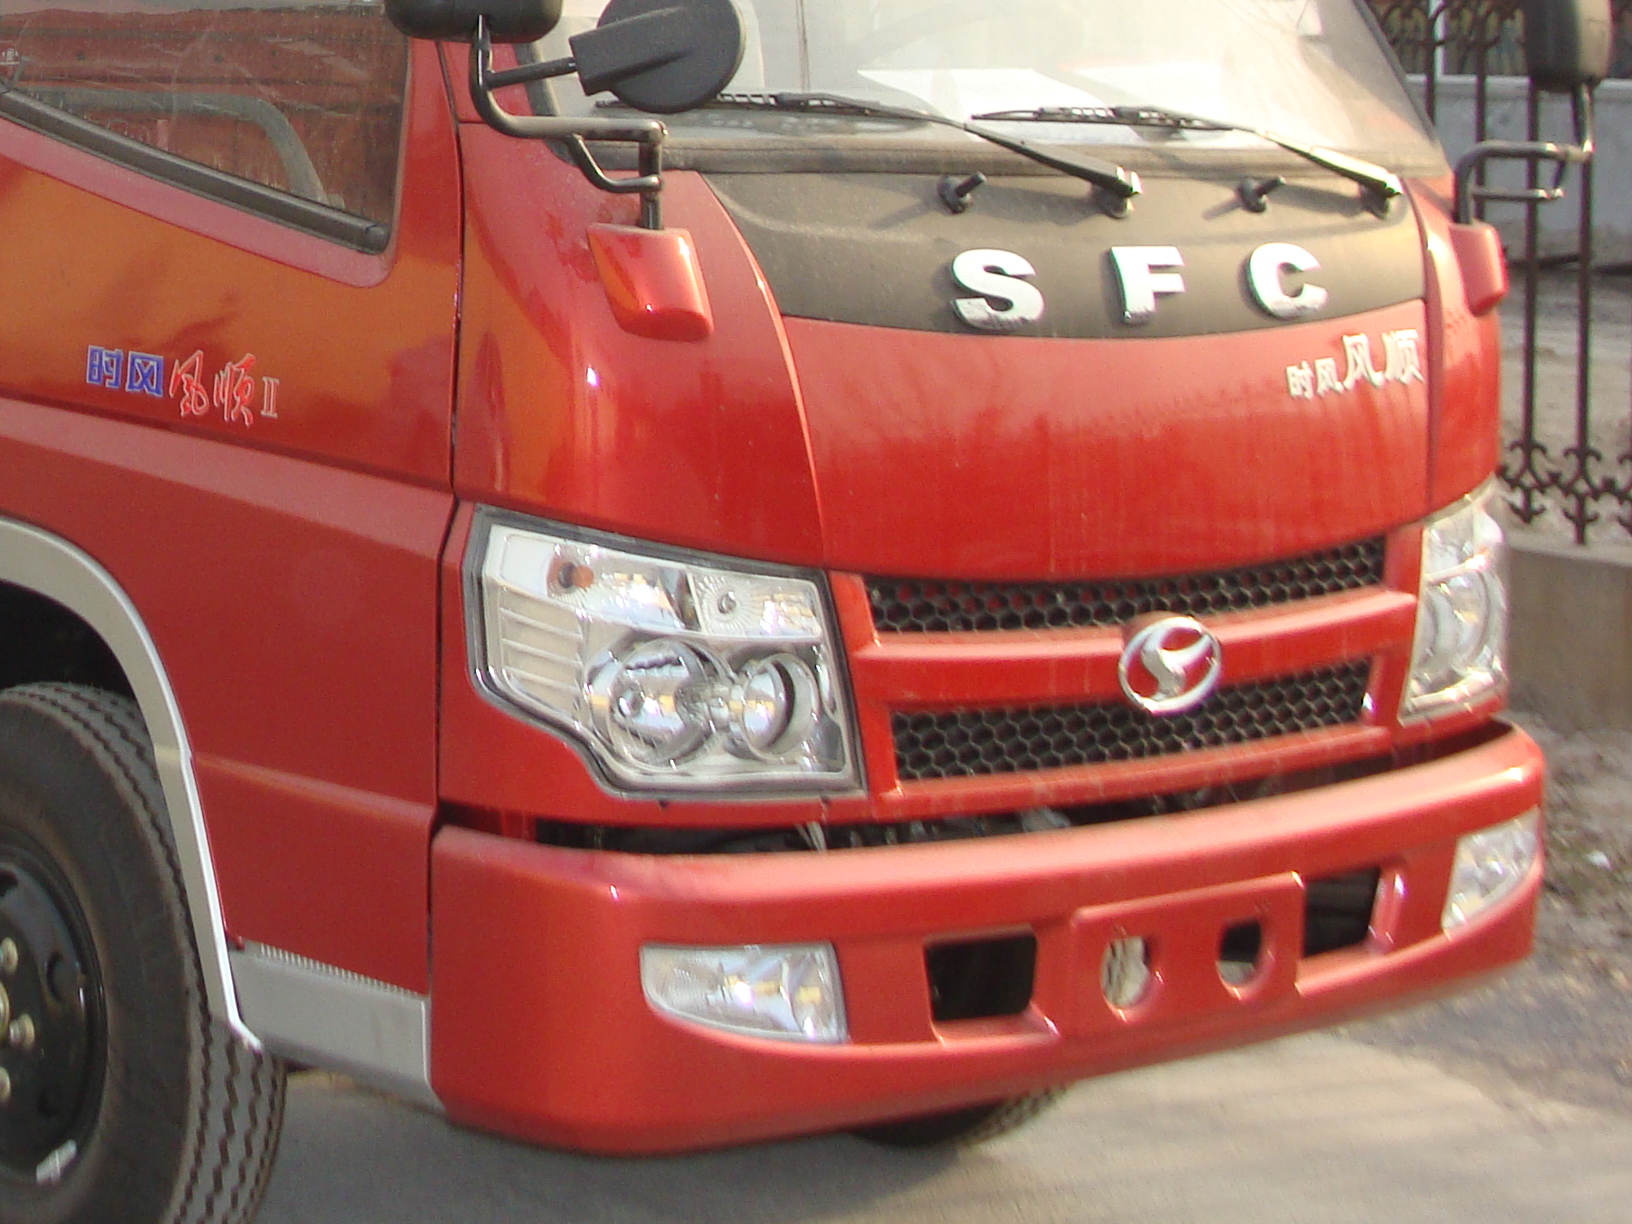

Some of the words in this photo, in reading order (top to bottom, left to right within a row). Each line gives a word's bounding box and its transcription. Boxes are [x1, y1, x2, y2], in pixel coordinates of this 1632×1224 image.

[950, 242, 1330, 330] SFC
[1285, 328, 1425, 399] 时风风顺
